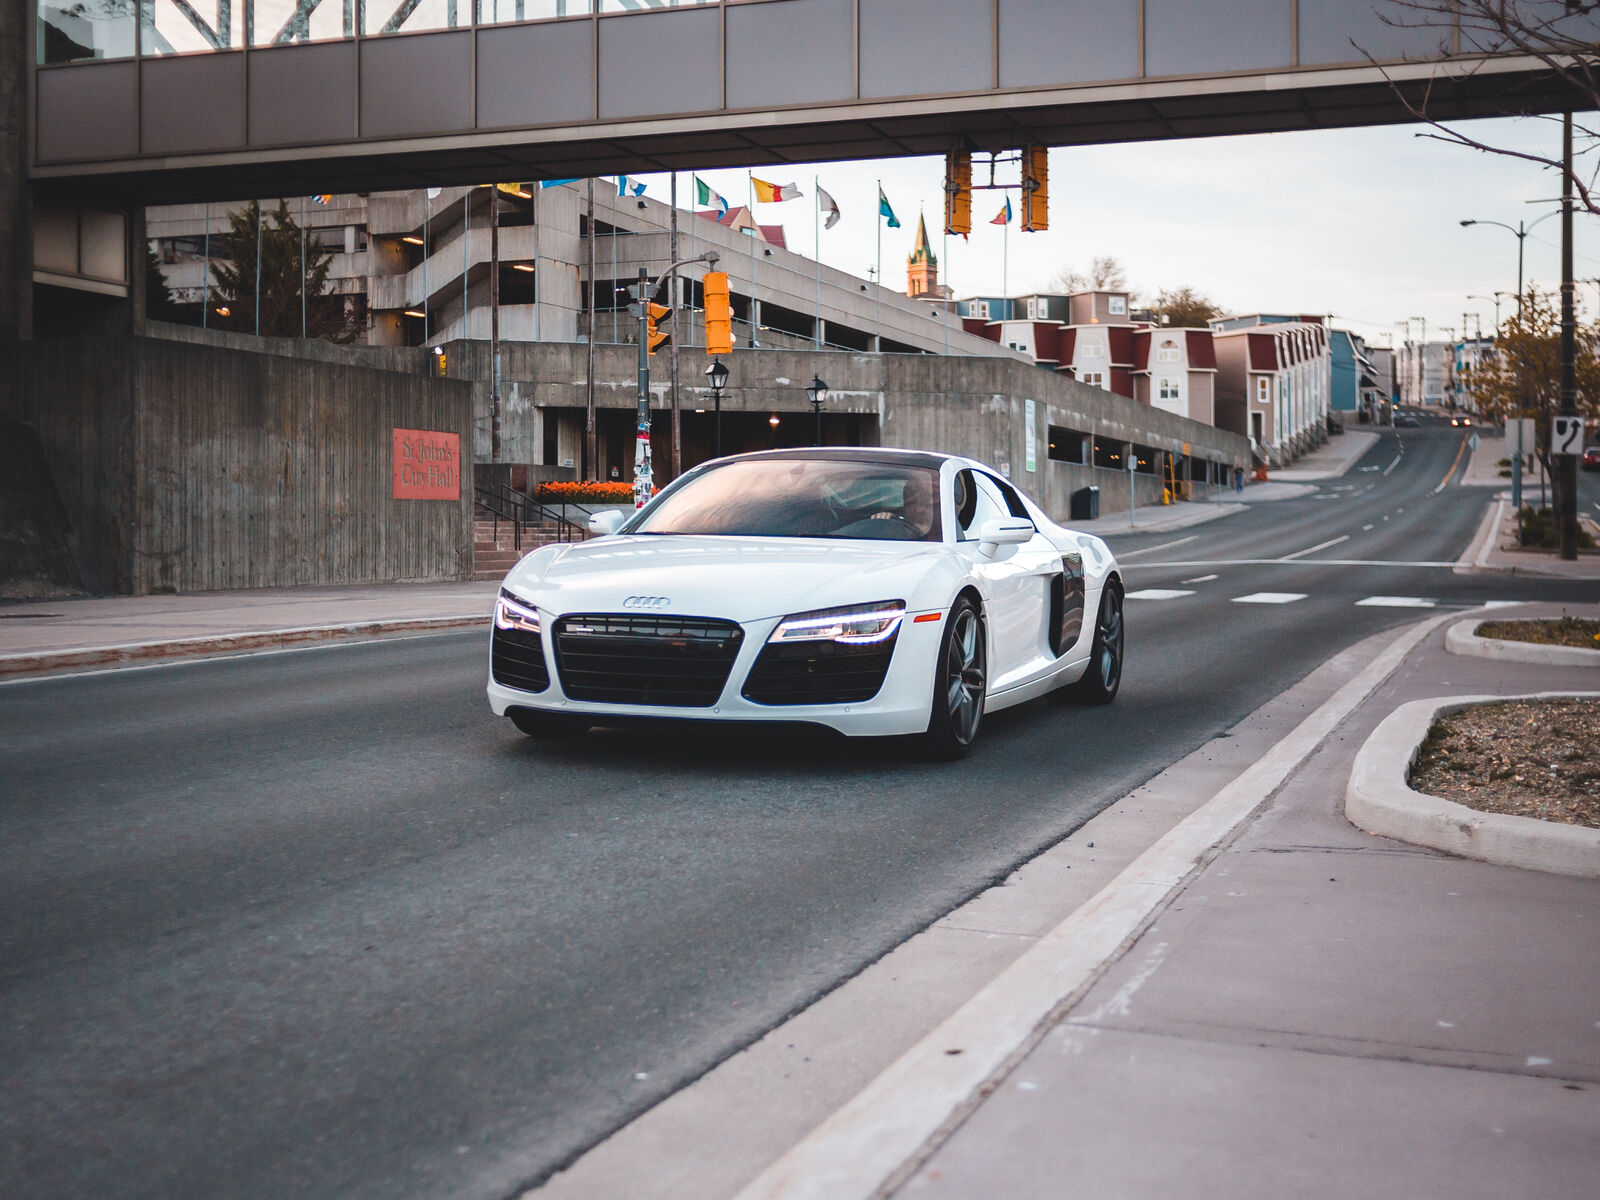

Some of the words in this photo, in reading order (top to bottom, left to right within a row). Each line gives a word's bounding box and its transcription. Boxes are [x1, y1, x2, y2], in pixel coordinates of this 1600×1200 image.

[418, 440, 453, 464] John's
[401, 464, 427, 490] City
[428, 465, 454, 488] Hall
